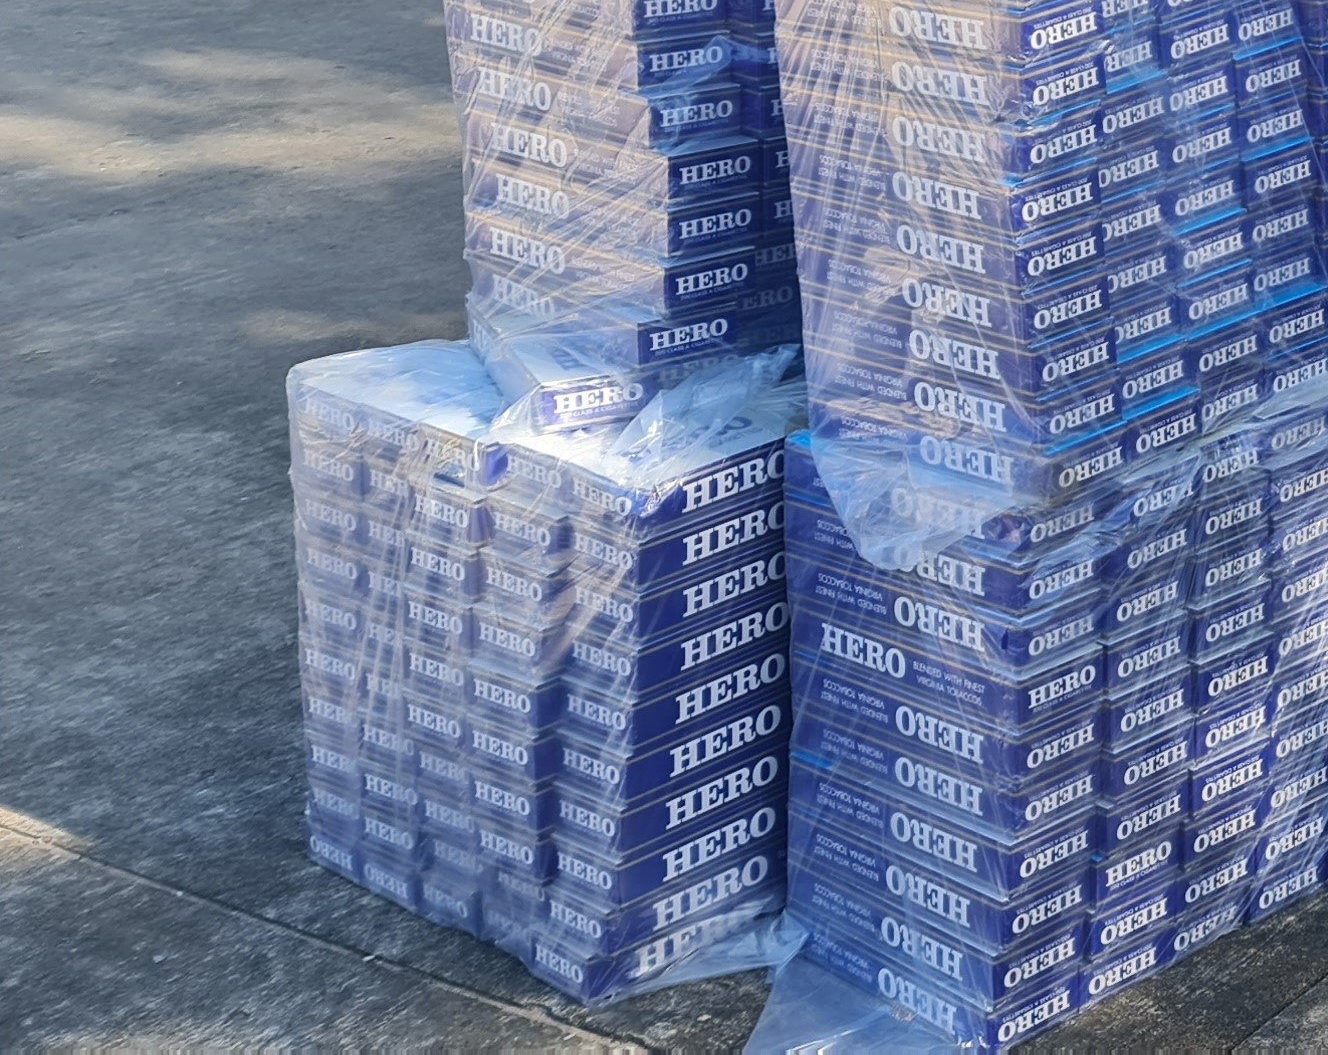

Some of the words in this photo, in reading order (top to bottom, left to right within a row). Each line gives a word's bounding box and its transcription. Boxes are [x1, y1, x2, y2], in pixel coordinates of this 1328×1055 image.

[889, 7, 986, 50] HERO
[1030, 11, 1097, 49] HERO
[679, 156, 751, 185] HERO
[1022, 181, 1093, 222] HERO
[679, 209, 752, 239] HERO
[1027, 236, 1097, 276] HERO
[1184, 233, 1243, 269] HERO
[675, 263, 748, 295] HERO
[902, 278, 992, 327] HERO
[649, 318, 728, 351] HERO
[909, 330, 1000, 379] HERO
[1199, 335, 1257, 372] HERO
[553, 383, 644, 414] HERO
[914, 382, 1006, 432] HERO
[682, 449, 785, 513] HERO
[682, 501, 785, 566] HERO
[412, 547, 465, 581] HERO
[487, 566, 541, 601] HERO
[682, 551, 786, 617] HERO
[681, 602, 789, 671] HERO
[893, 597, 985, 652] HERO
[1206, 604, 1264, 642] HERO
[573, 640, 631, 677] HERO
[821, 623, 906, 679] HERO
[473, 678, 531, 714] HERO
[675, 653, 785, 724] HERO
[1028, 665, 1096, 709] HERO
[408, 704, 460, 738] HERO
[669, 705, 781, 778] HERO
[895, 706, 985, 764] HERO
[473, 731, 528, 766] HERO
[563, 748, 620, 785] HERO
[1027, 724, 1094, 768] HERO
[474, 781, 530, 816] HERO
[666, 756, 778, 830] HERO
[1202, 760, 1262, 801] HERO
[310, 836, 352, 870] HERO
[663, 807, 775, 882] HERO
[890, 812, 978, 872] HERO
[1105, 841, 1171, 886] HERO
[558, 851, 612, 890] HERO
[652, 855, 768, 931] HERO
[885, 864, 971, 928] HERO
[1012, 885, 1082, 934] HERO
[550, 900, 601, 939] HERO
[1101, 898, 1167, 945] HERO
[998, 990, 1070, 1042] HERO
